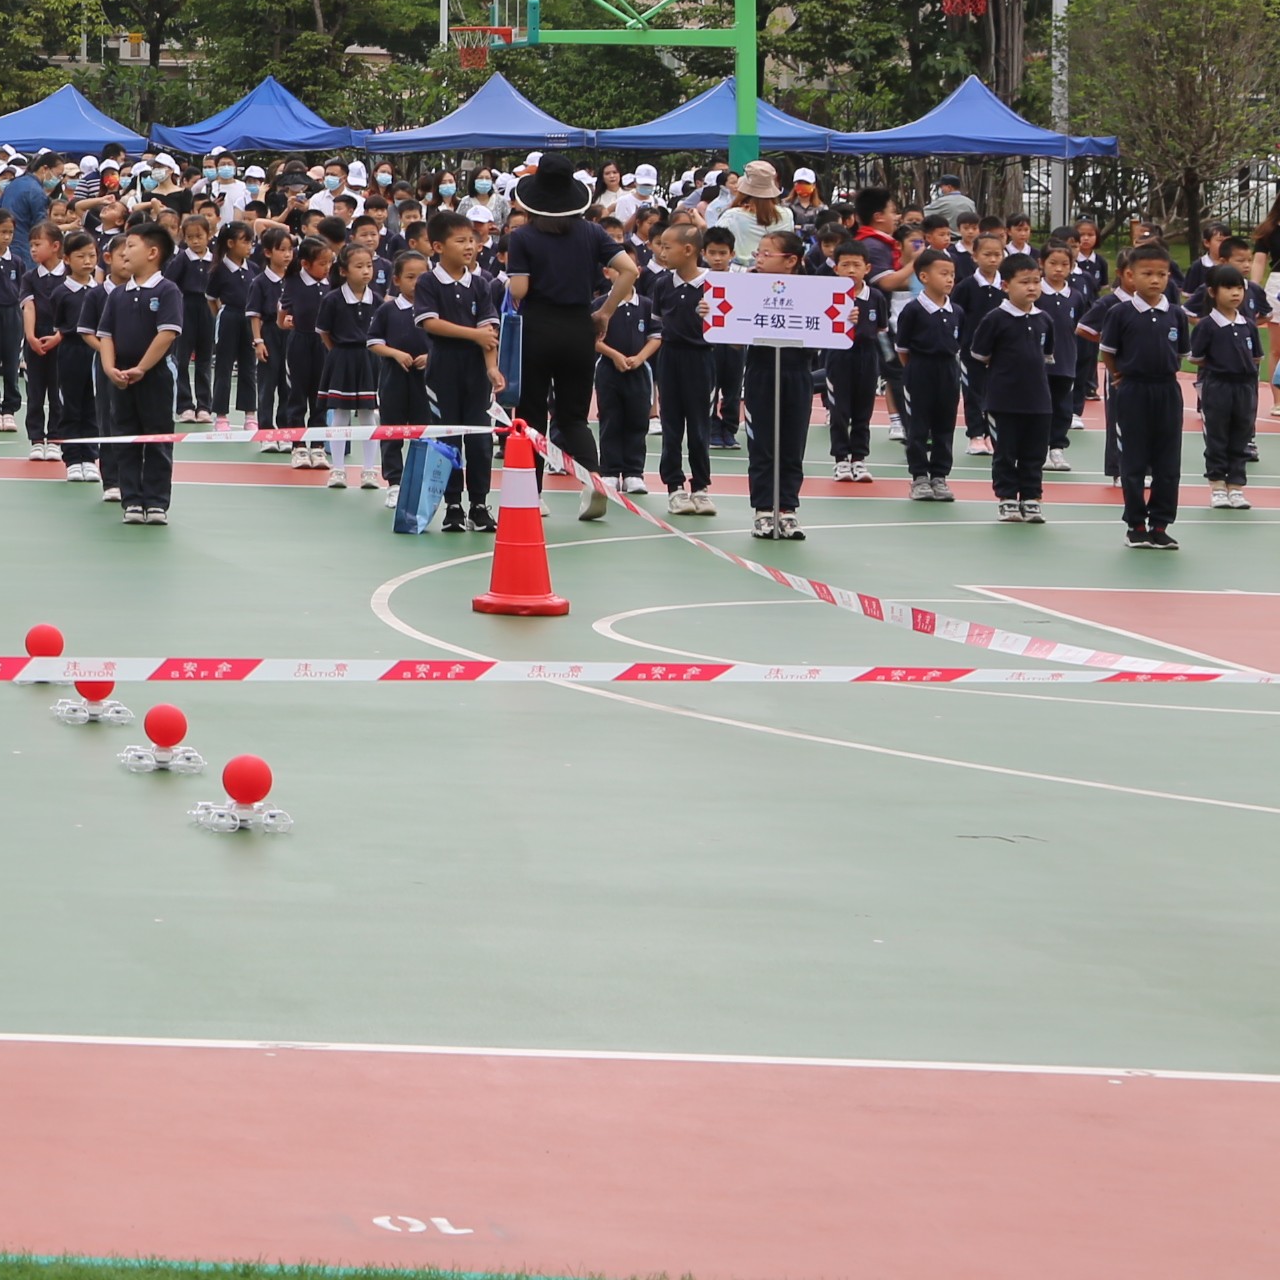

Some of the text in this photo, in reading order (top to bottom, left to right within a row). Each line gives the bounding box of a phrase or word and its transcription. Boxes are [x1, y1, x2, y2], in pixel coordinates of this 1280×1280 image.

[737, 313, 820, 330] 一年级三班
[66, 661, 117, 671] 注意
[183, 661, 232, 672] 安全
[171, 670, 223, 678] SAFE
[372, 1215, 474, 1235] 10
